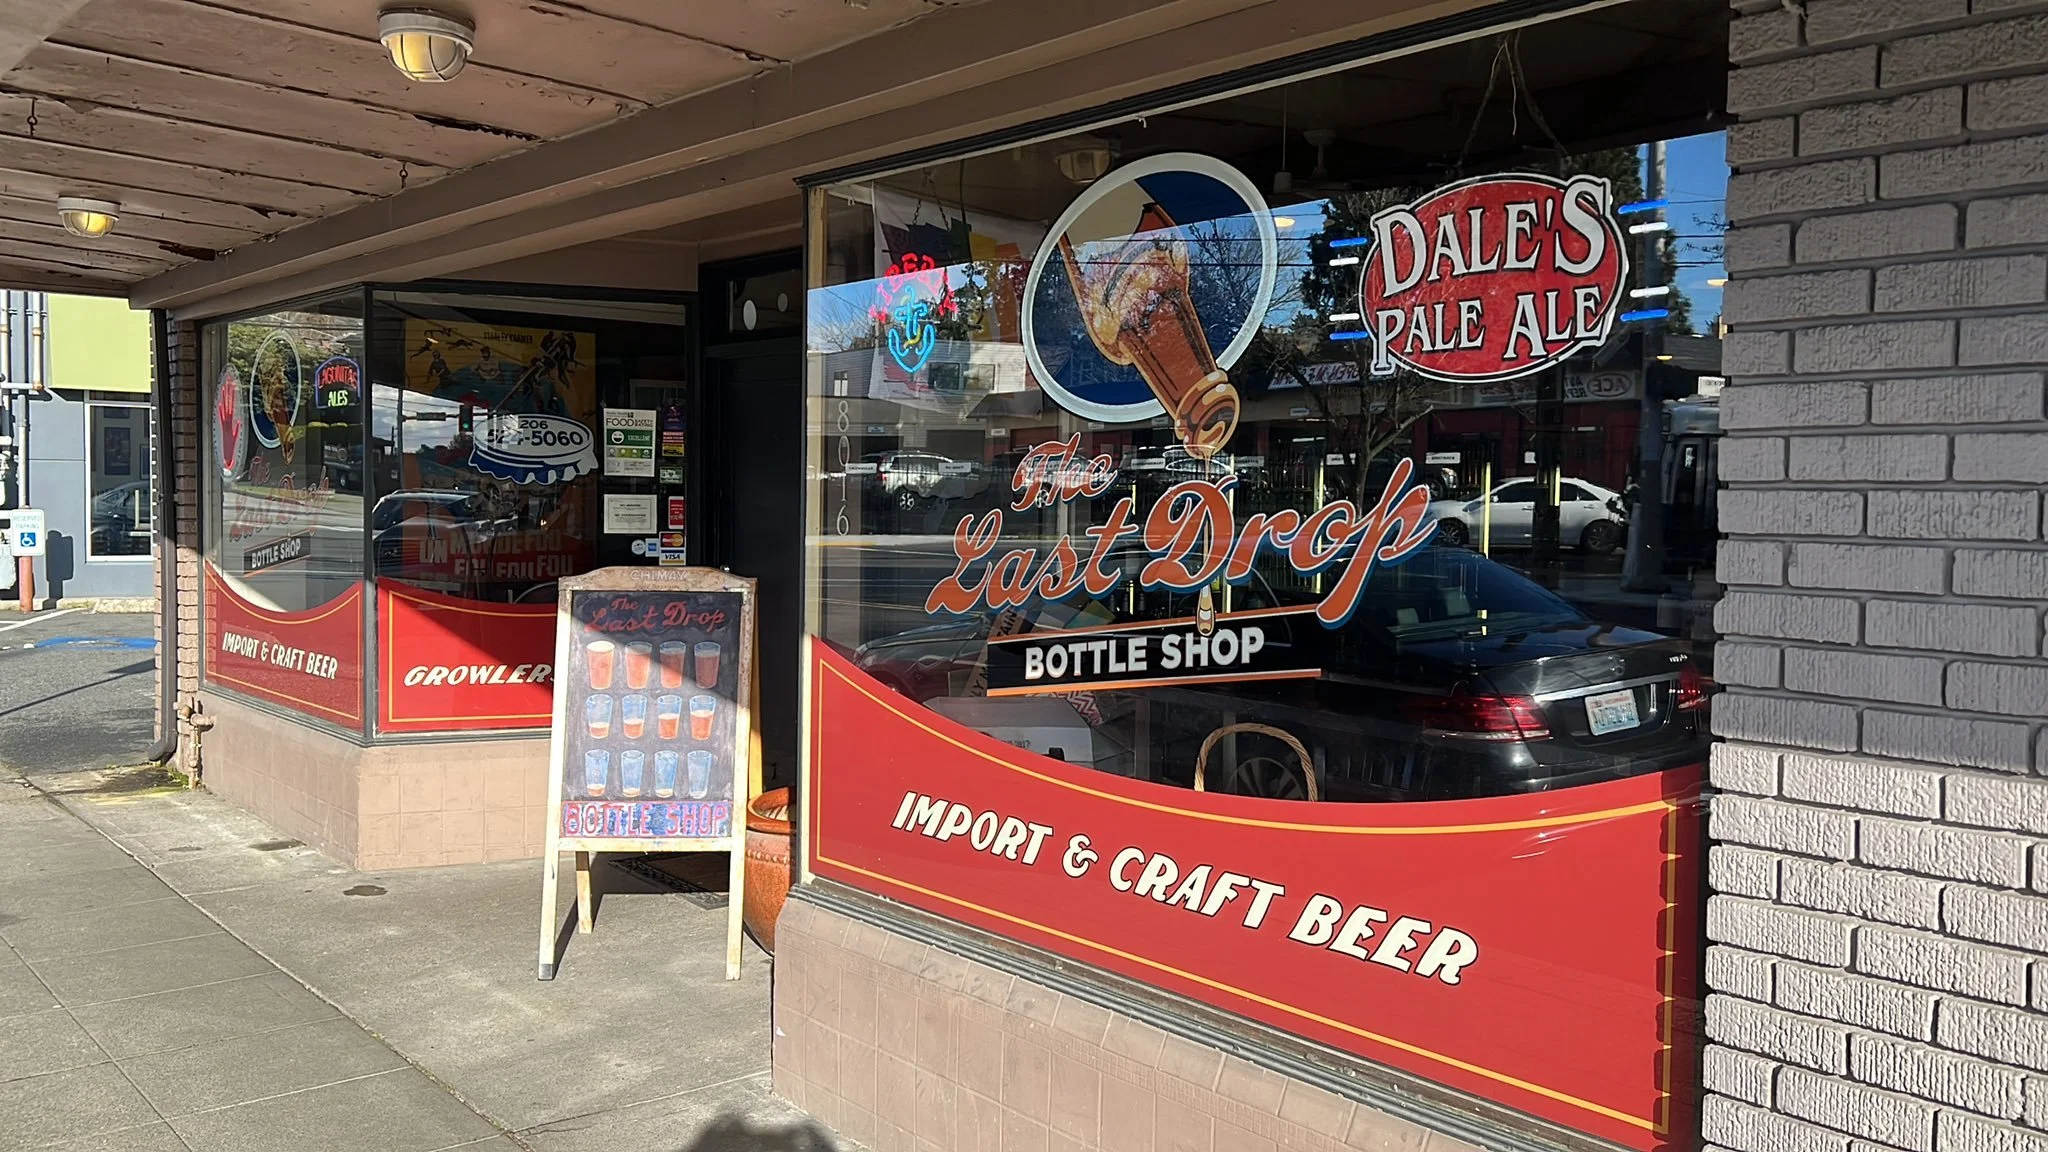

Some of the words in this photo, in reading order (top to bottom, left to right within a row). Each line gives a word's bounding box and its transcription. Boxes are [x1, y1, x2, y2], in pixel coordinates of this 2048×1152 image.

[1373, 179, 1608, 298] DALE'S
[1376, 298, 1488, 370] PALE
[1503, 286, 1603, 360] ALE
[318, 364, 358, 389] LAGUNITAS
[328, 390, 348, 408] ALES
[520, 420, 548, 430] 206
[606, 417, 635, 427] FOOD
[1010, 431, 1119, 512] The
[251, 548, 279, 569] BOTTLE
[280, 538, 301, 562] SHOP
[924, 496, 1139, 618] Last
[1140, 456, 1439, 630] Drop
[629, 569, 686, 581] CHIMAY
[584, 604, 660, 634] Last
[662, 600, 727, 633] Drop
[611, 598, 639, 611] The
[222, 631, 260, 659] IMPORT
[261, 644, 269, 662] &
[270, 643, 306, 672] CRAFT
[305, 652, 339, 680] BEER
[1024, 637, 1148, 681] BOTTLE
[1160, 626, 1266, 671] SHOP
[403, 664, 554, 686] GROWLER
[564, 802, 653, 837] BOTTLE
[666, 803, 728, 837] SHOP
[891, 790, 1054, 866] IMPORT
[1061, 832, 1099, 878] &
[1108, 845, 1286, 930] CRAFT
[1288, 893, 1479, 987] BEER
